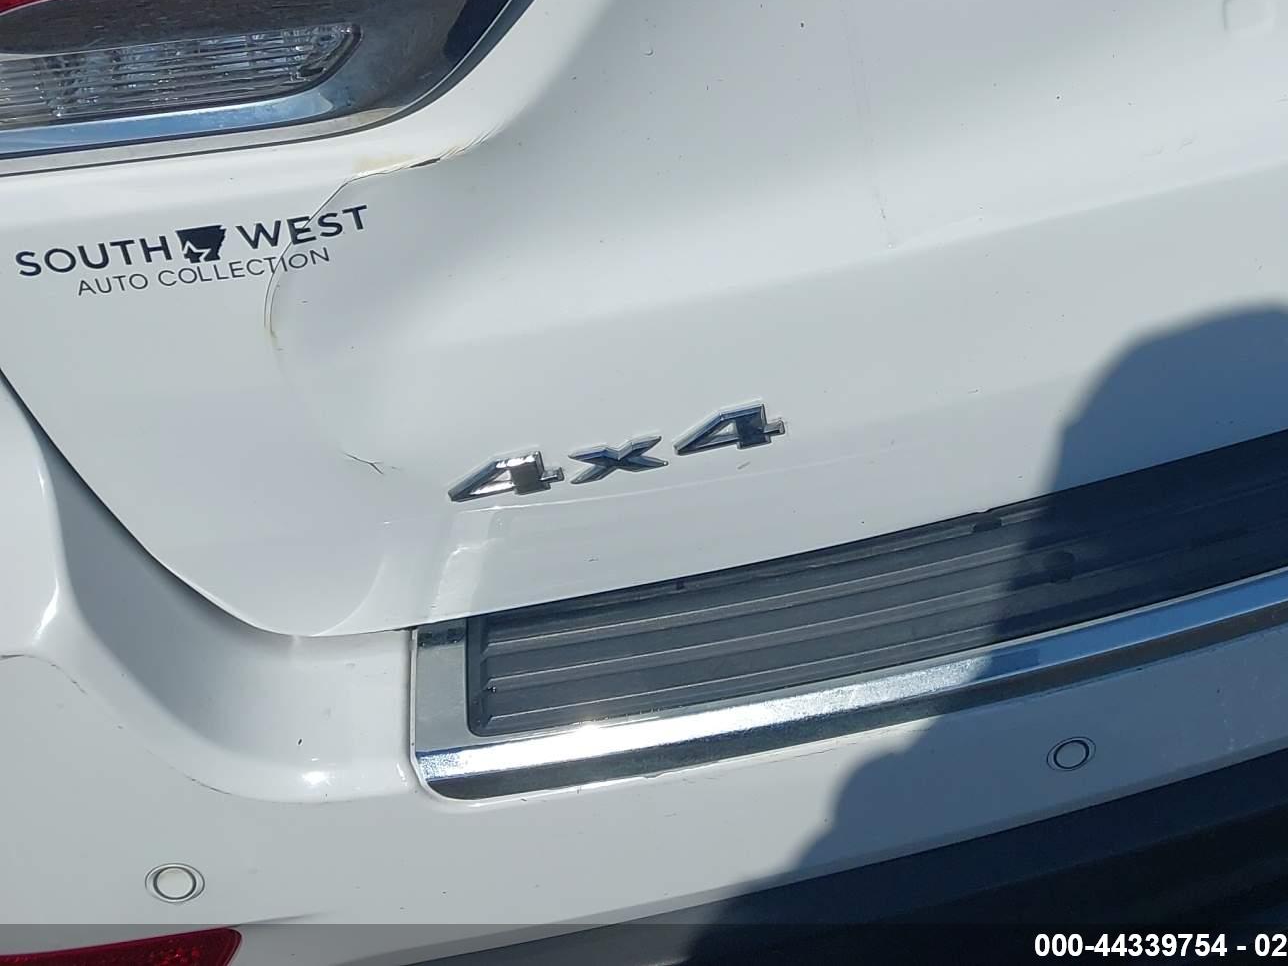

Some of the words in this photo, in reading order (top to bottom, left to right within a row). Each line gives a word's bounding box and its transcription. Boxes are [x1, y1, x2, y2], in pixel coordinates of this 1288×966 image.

[15, 235, 173, 277] SOUTH
[235, 204, 368, 251] WEST
[77, 273, 149, 297] AUTO
[157, 246, 331, 287] COLLECTION
